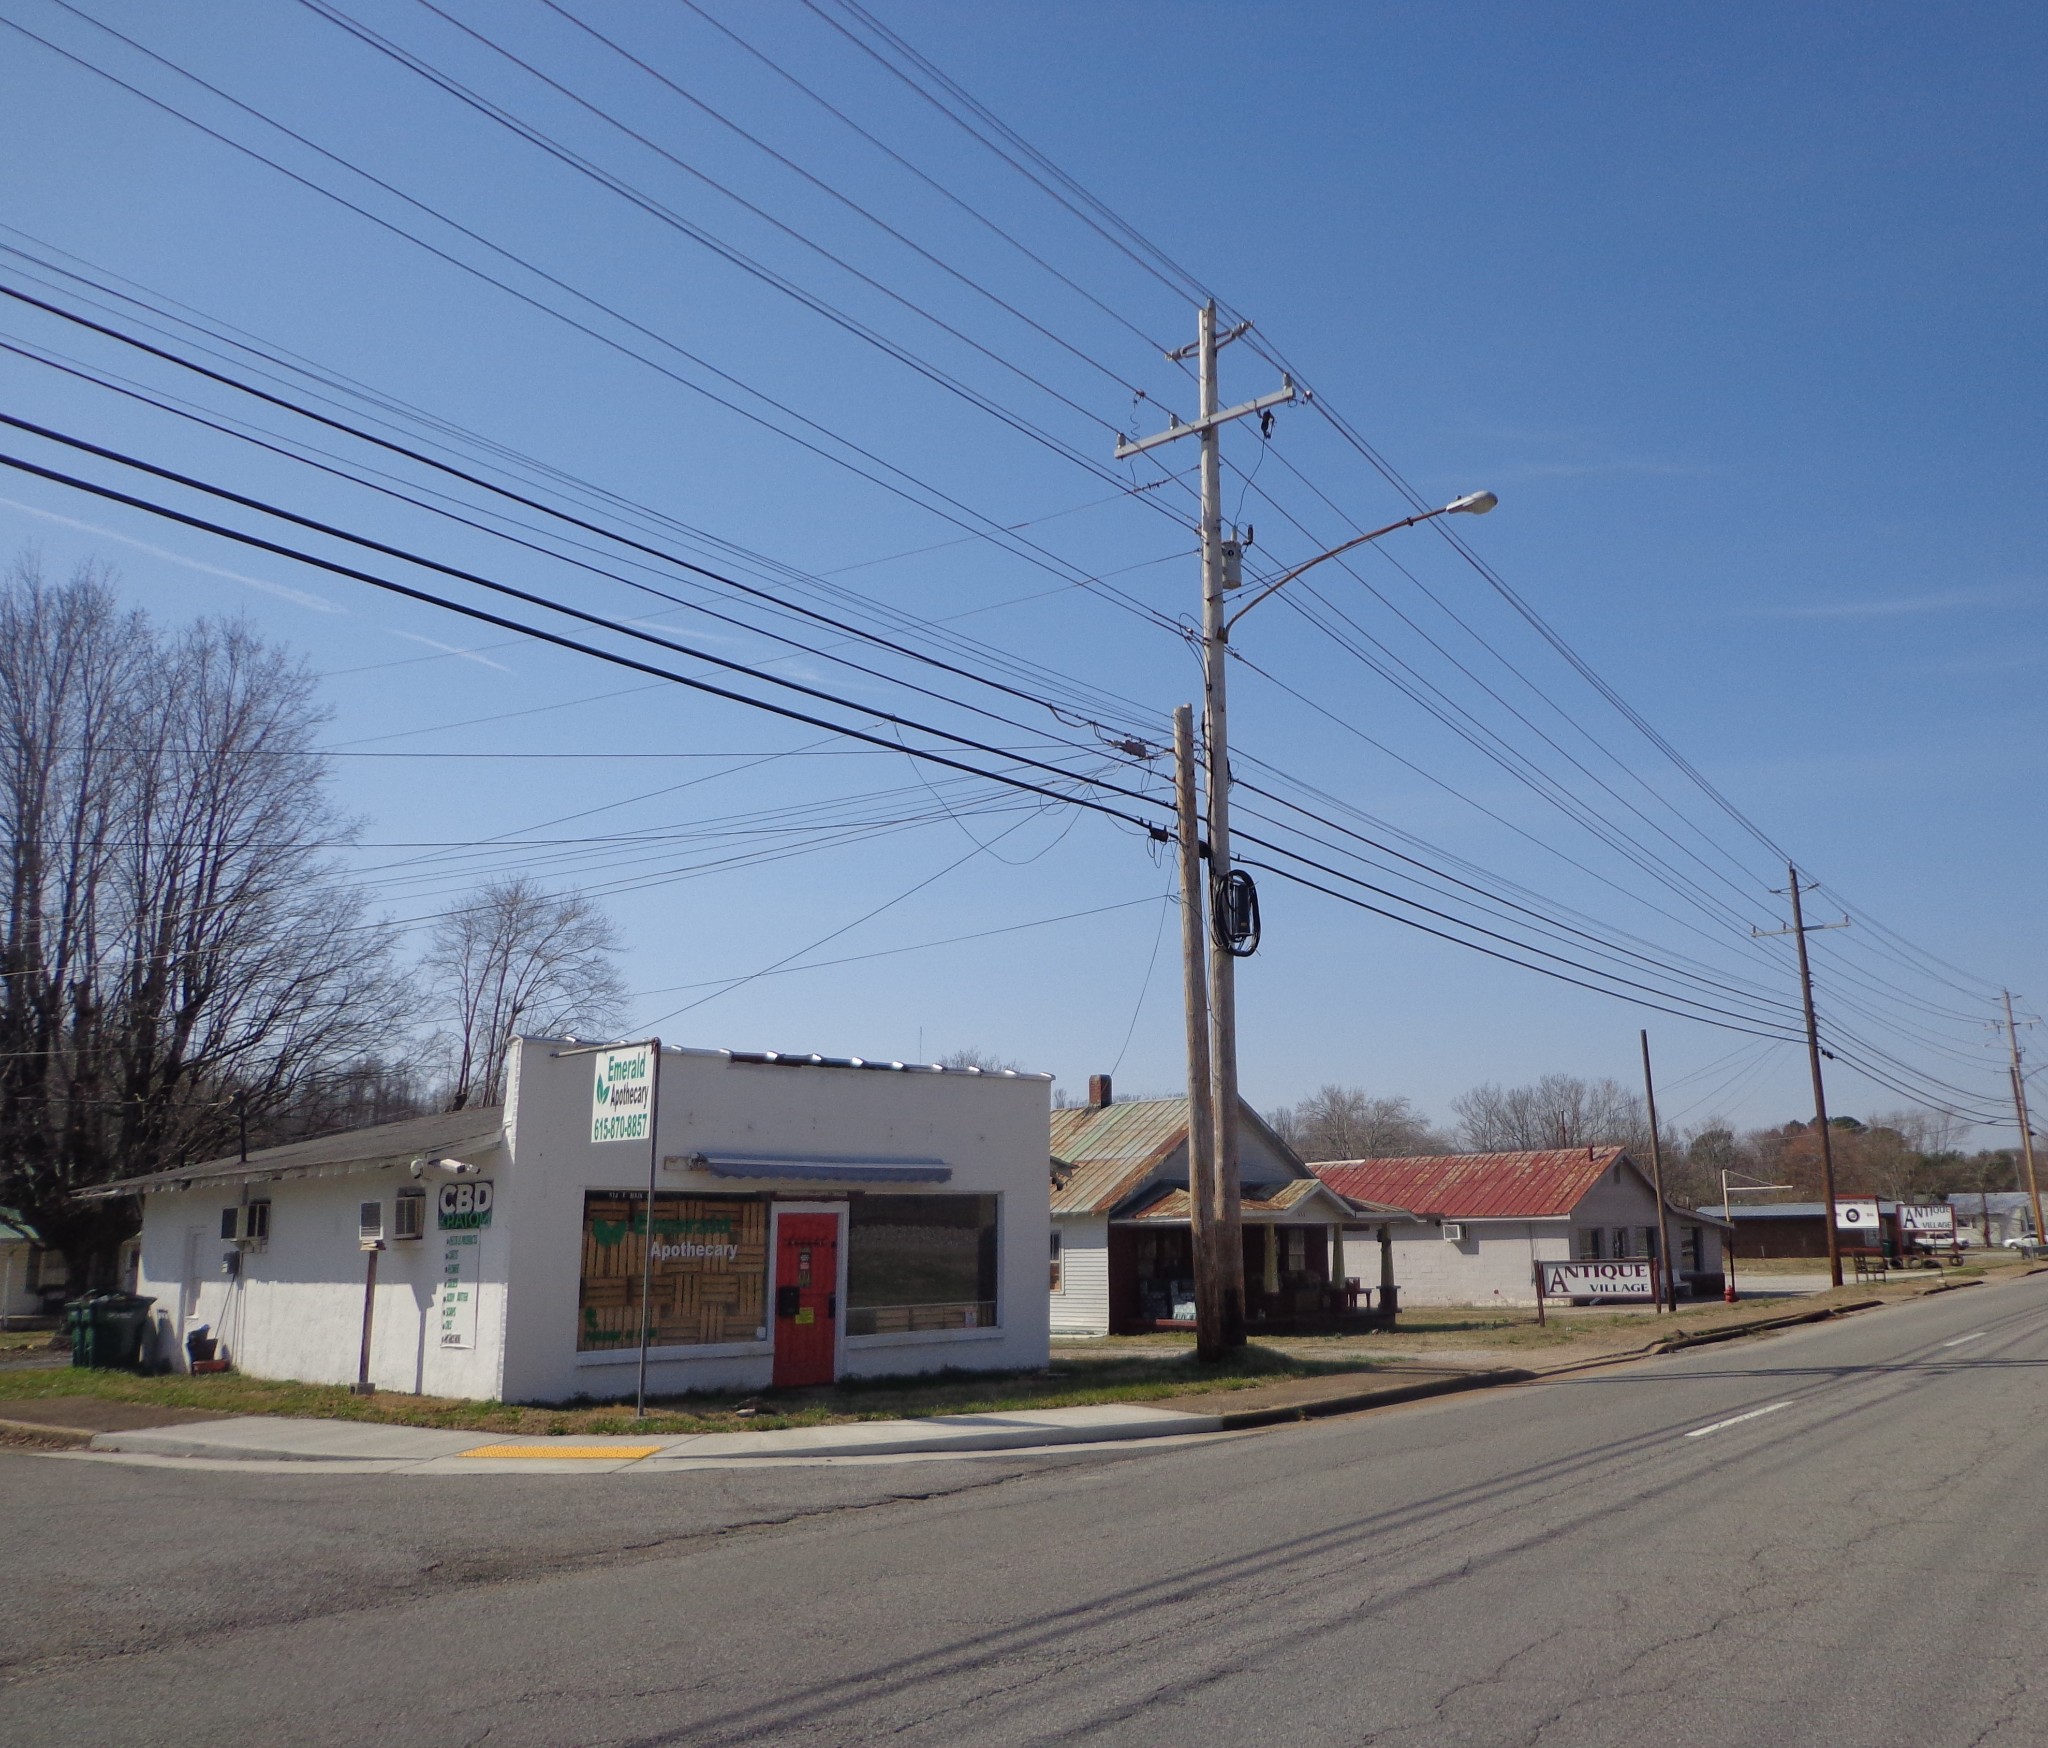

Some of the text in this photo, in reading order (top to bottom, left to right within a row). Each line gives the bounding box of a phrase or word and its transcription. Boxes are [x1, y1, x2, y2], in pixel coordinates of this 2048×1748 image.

[608, 1052, 646, 1082] Emerald
[610, 1083, 649, 1112] Apothecary
[594, 1113, 648, 1141] 615-870-8857
[440, 1182, 493, 1214] CBD
[1903, 1205, 1951, 1228] ANTIQUE
[650, 1241, 738, 1260] Apothecary
[1549, 1264, 1648, 1293] ANTIQUE
[1589, 1283, 1649, 1293] VILLAGE
